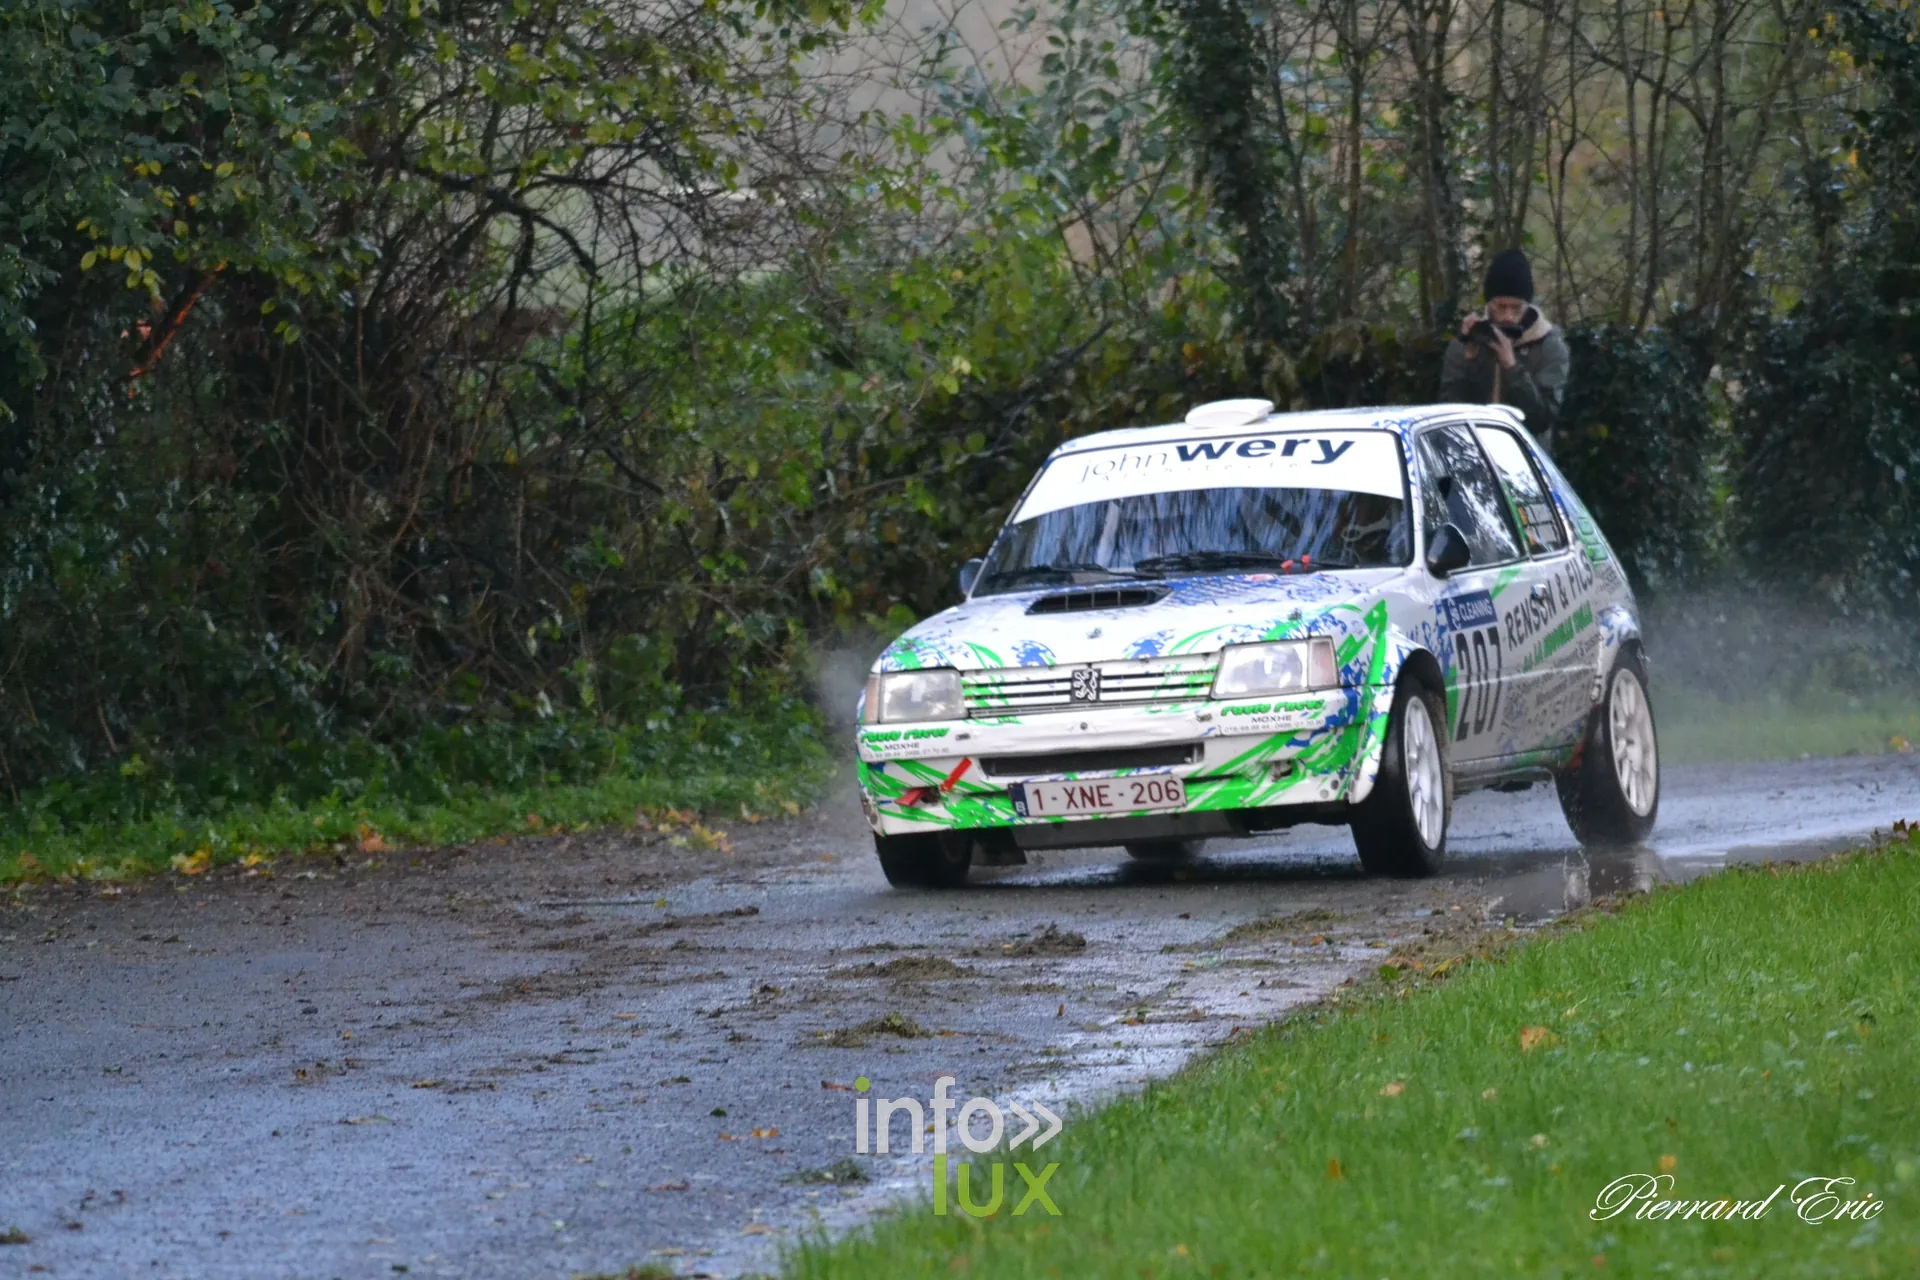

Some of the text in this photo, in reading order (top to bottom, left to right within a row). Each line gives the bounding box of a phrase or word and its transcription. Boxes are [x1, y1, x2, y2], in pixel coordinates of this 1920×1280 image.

[1080, 438, 1355, 483] john wery
[1555, 572, 1569, 610] &
[1565, 549, 1594, 601] FILS
[1458, 601, 1493, 623] CLEANING
[1455, 626, 1502, 742] 207
[1251, 714, 1292, 724] MOXHE
